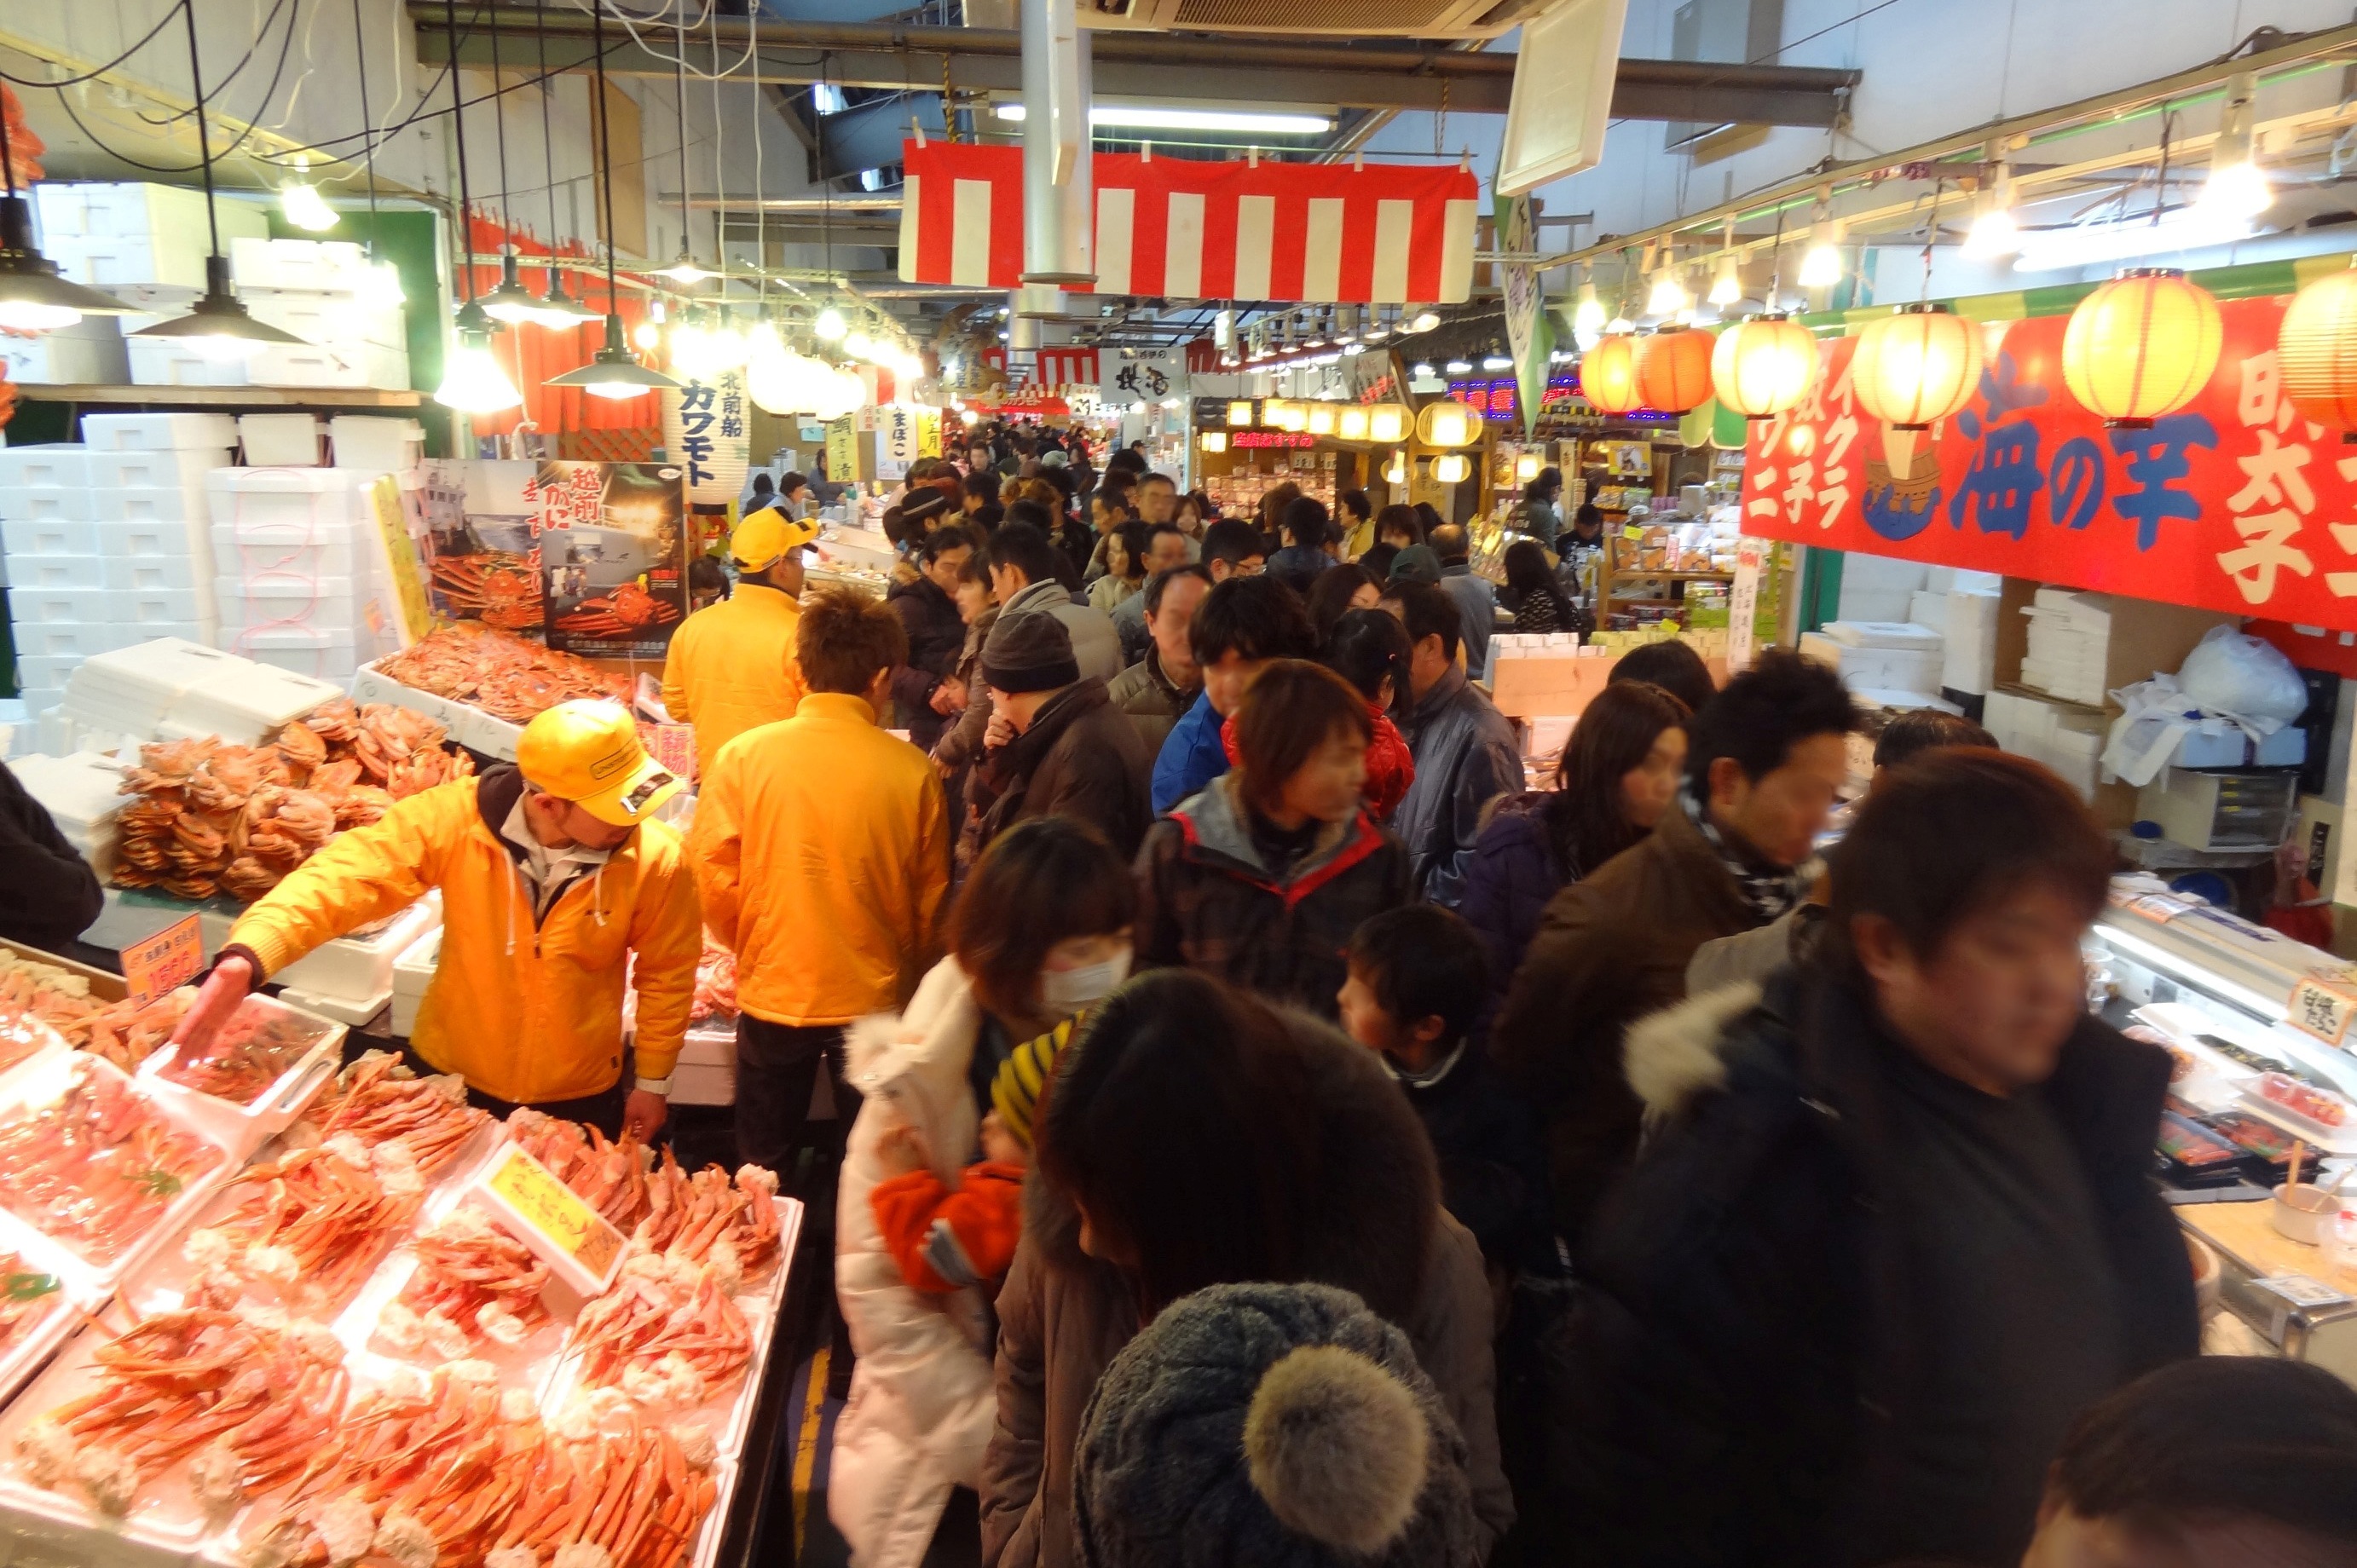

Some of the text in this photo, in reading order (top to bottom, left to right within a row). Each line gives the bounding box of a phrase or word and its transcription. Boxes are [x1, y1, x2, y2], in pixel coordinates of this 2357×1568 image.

[679, 378, 717, 487] カワモト
[720, 372, 742, 438] 北前船
[892, 406, 908, 457] まぼこ
[1232, 432, 1314, 448] 当店おすすめ
[1817, 358, 1859, 529] イクラ
[1948, 350, 2220, 552] 海の幸
[571, 468, 600, 522] 越前
